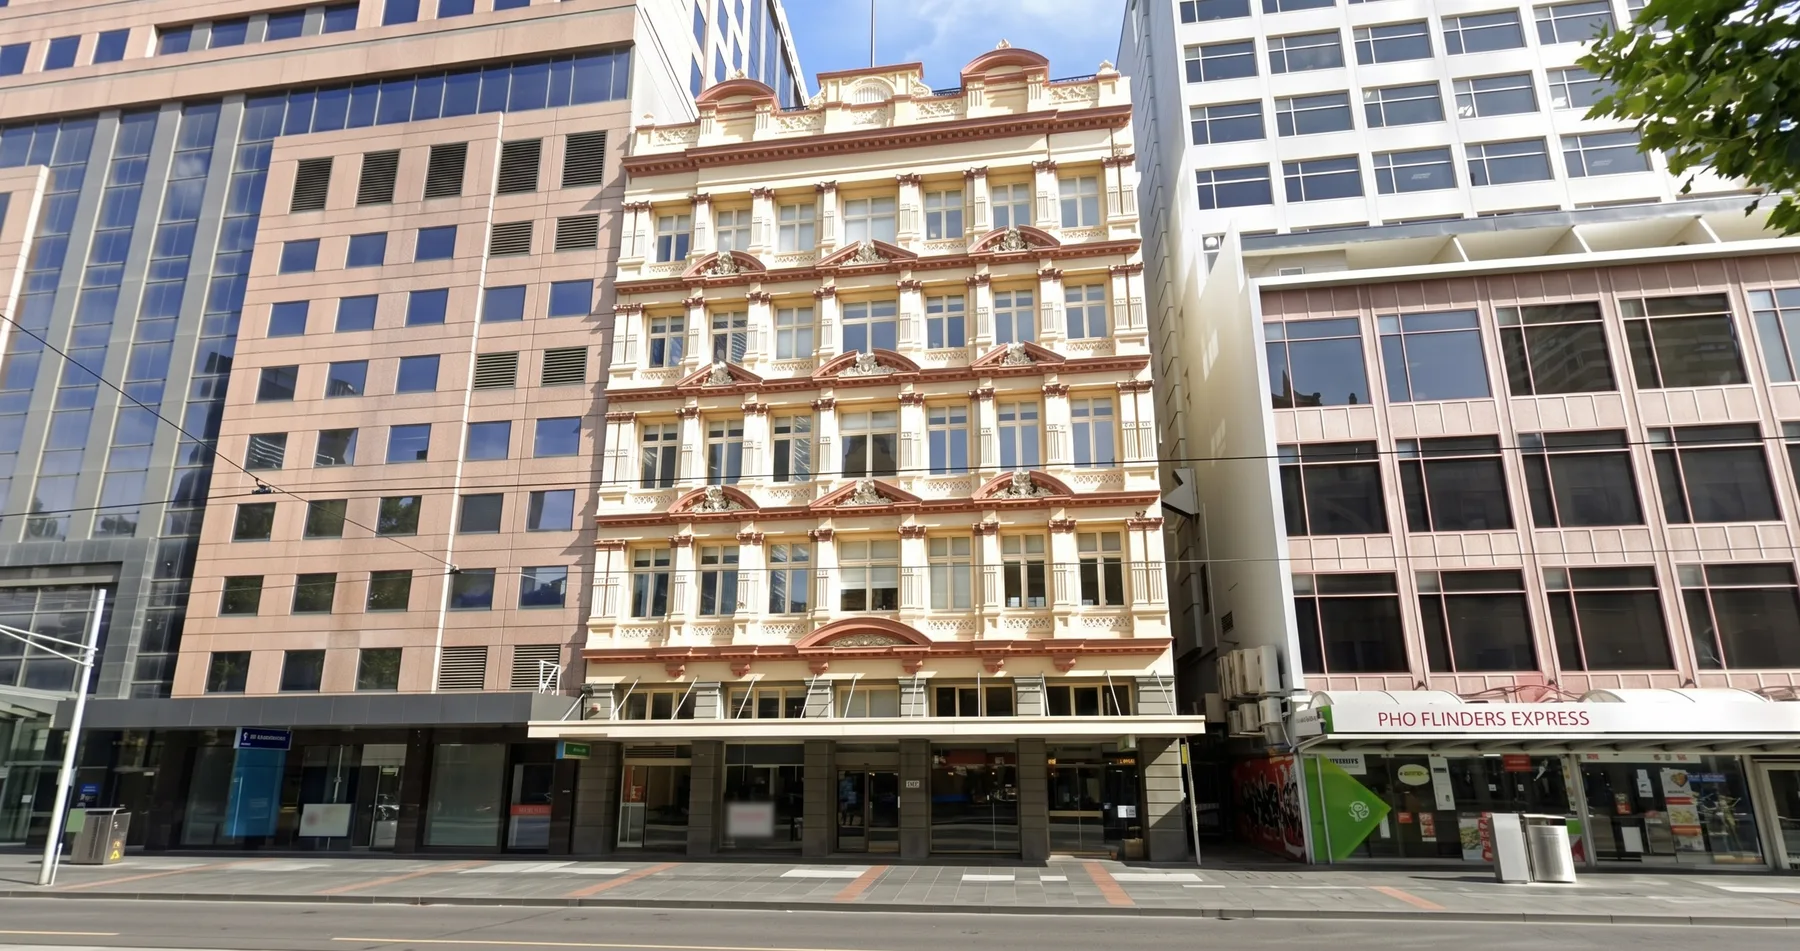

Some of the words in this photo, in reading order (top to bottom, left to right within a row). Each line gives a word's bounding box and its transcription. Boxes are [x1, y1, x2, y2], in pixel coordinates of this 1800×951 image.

[1378, 711, 1417, 727] PHO
[1422, 711, 1507, 727] FLINDERS
[1511, 711, 1590, 726] EXPRESS
